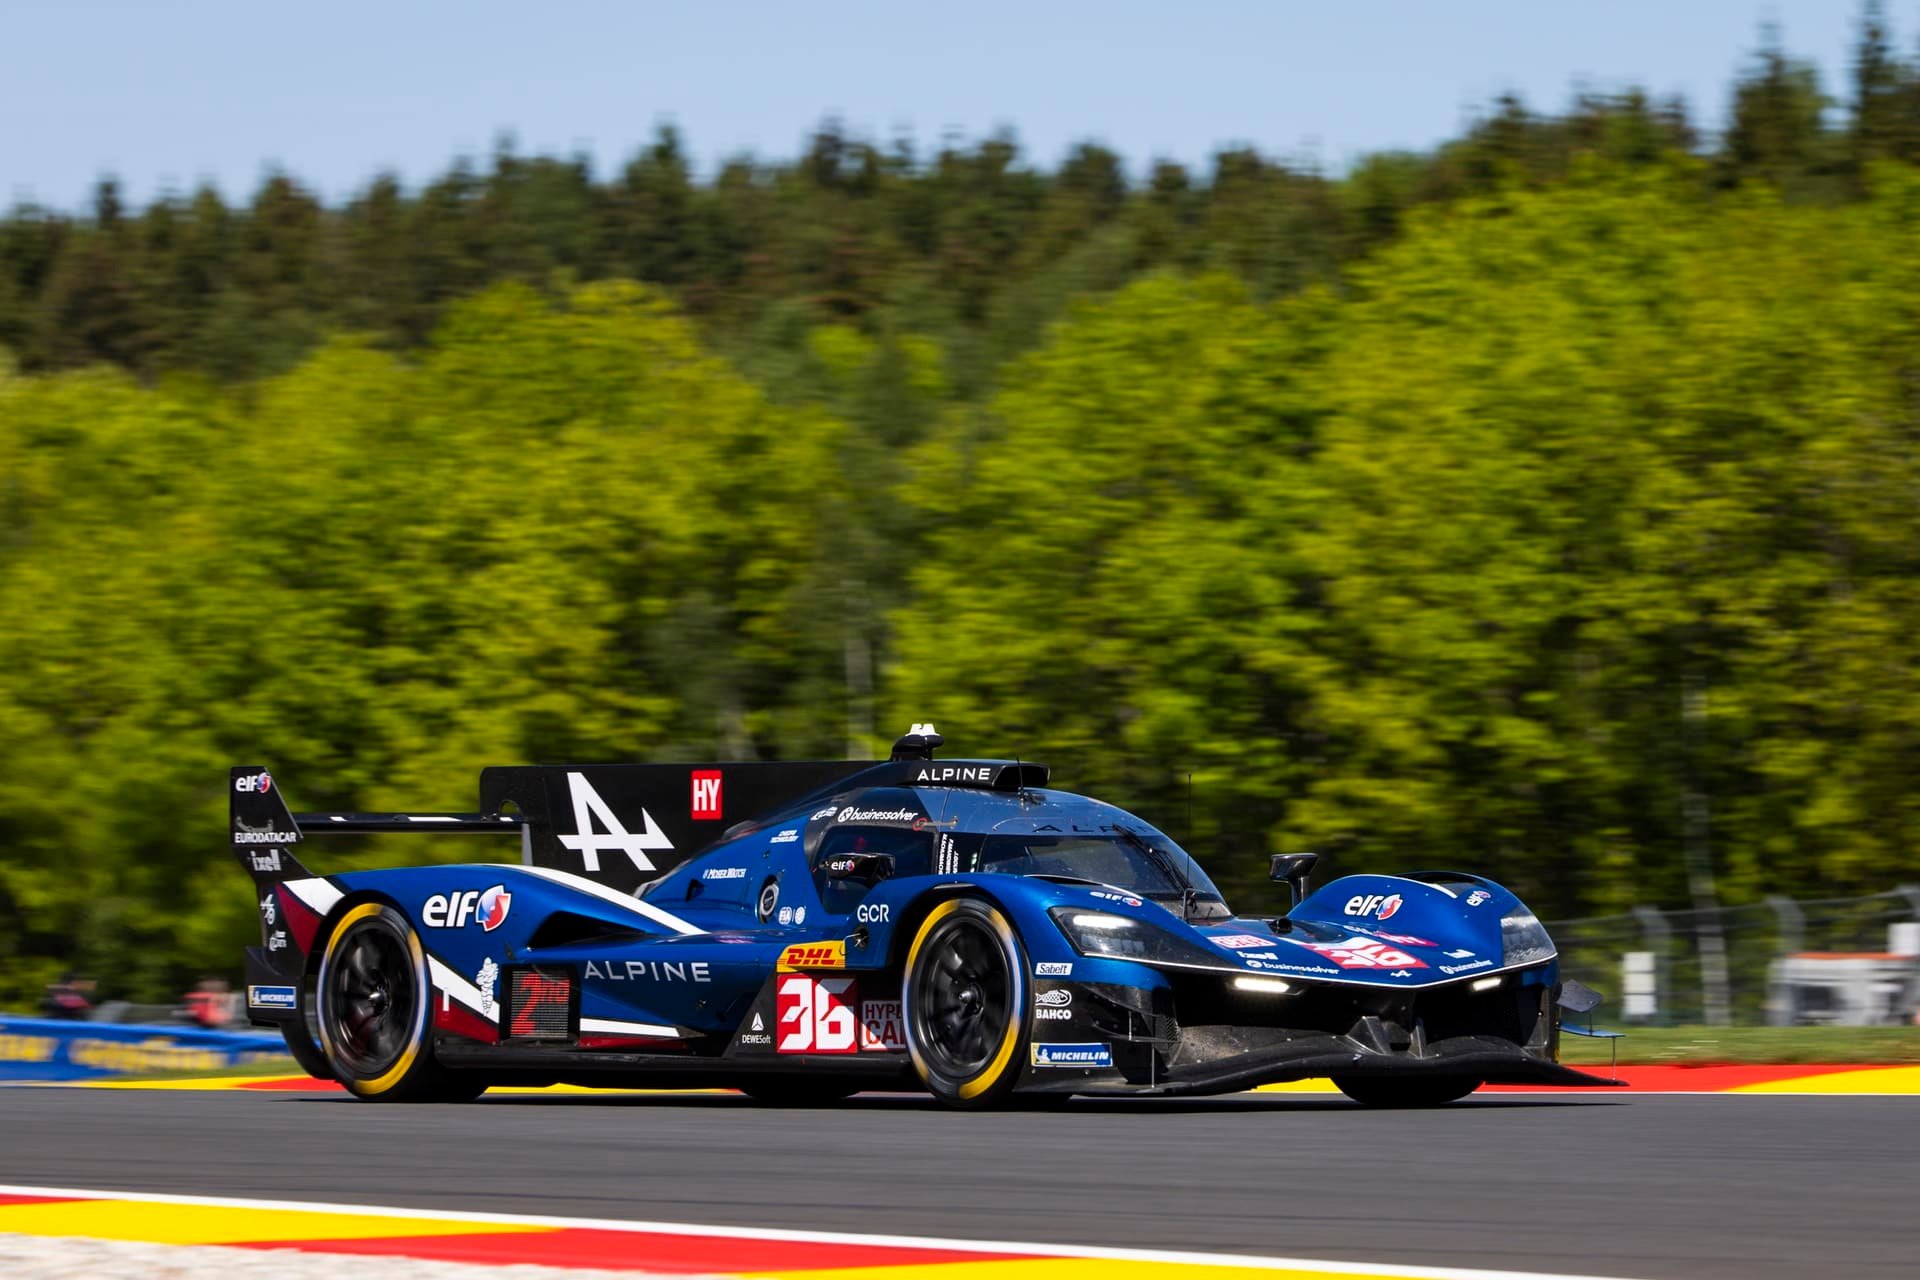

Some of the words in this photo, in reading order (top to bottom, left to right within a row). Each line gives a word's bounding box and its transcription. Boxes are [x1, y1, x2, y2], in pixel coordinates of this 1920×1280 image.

[917, 768, 991, 781] ALPINE
[235, 776, 257, 792] elf
[693, 779, 720, 811] HY
[851, 807, 919, 821] businessolver
[234, 832, 297, 843] EURODATACAR
[831, 861, 846, 870] elf
[422, 891, 479, 928] elf
[857, 904, 890, 922] GCR
[1344, 895, 1384, 916] elf
[786, 948, 836, 965] DHL
[584, 960, 711, 982] ALPINE
[1039, 963, 1068, 974] Sabelt
[778, 978, 855, 1049] 36
[1035, 1009, 1072, 1020] BAHCO
[742, 1034, 771, 1044] DEWESoft
[1051, 1052, 1109, 1060] MICHELIN
